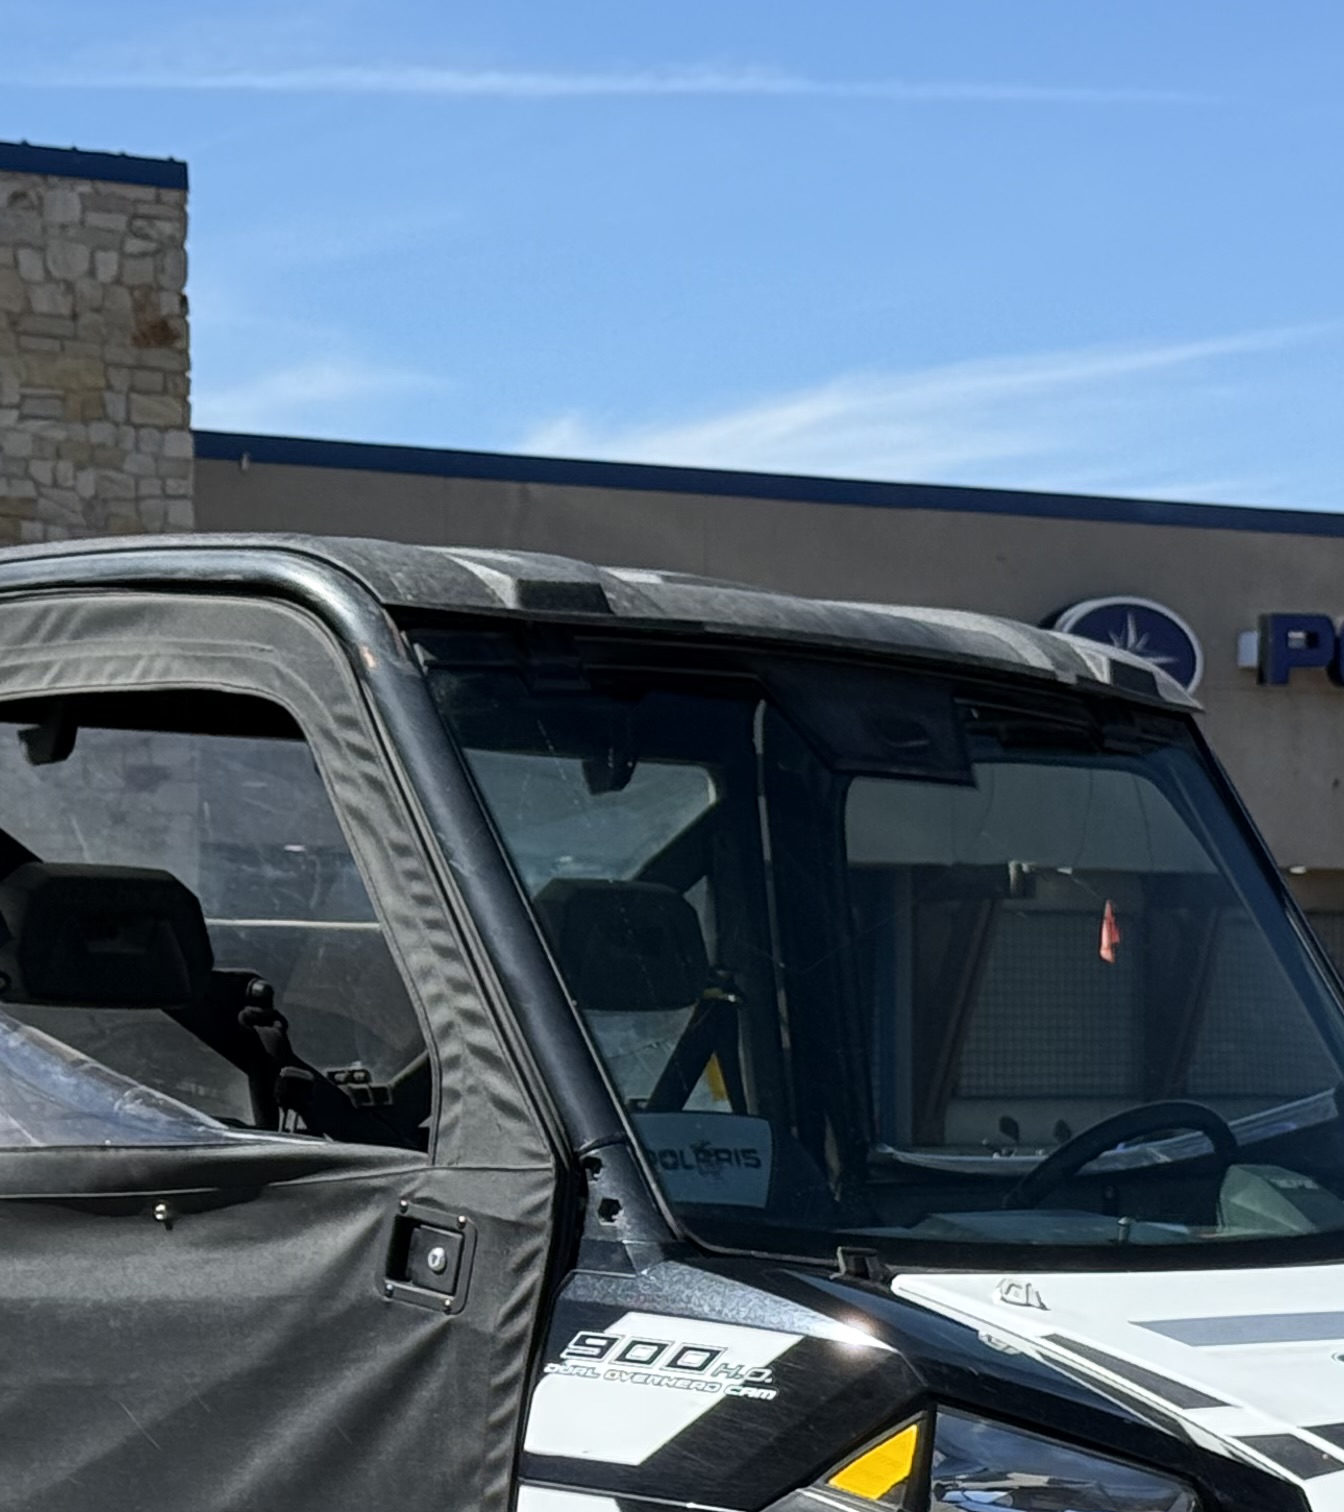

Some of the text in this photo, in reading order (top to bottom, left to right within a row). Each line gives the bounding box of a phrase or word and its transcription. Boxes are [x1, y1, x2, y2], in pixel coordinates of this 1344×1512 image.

[559, 1330, 728, 1376] 900
[543, 1361, 779, 1401] DUAL OVERHEAD CAM
